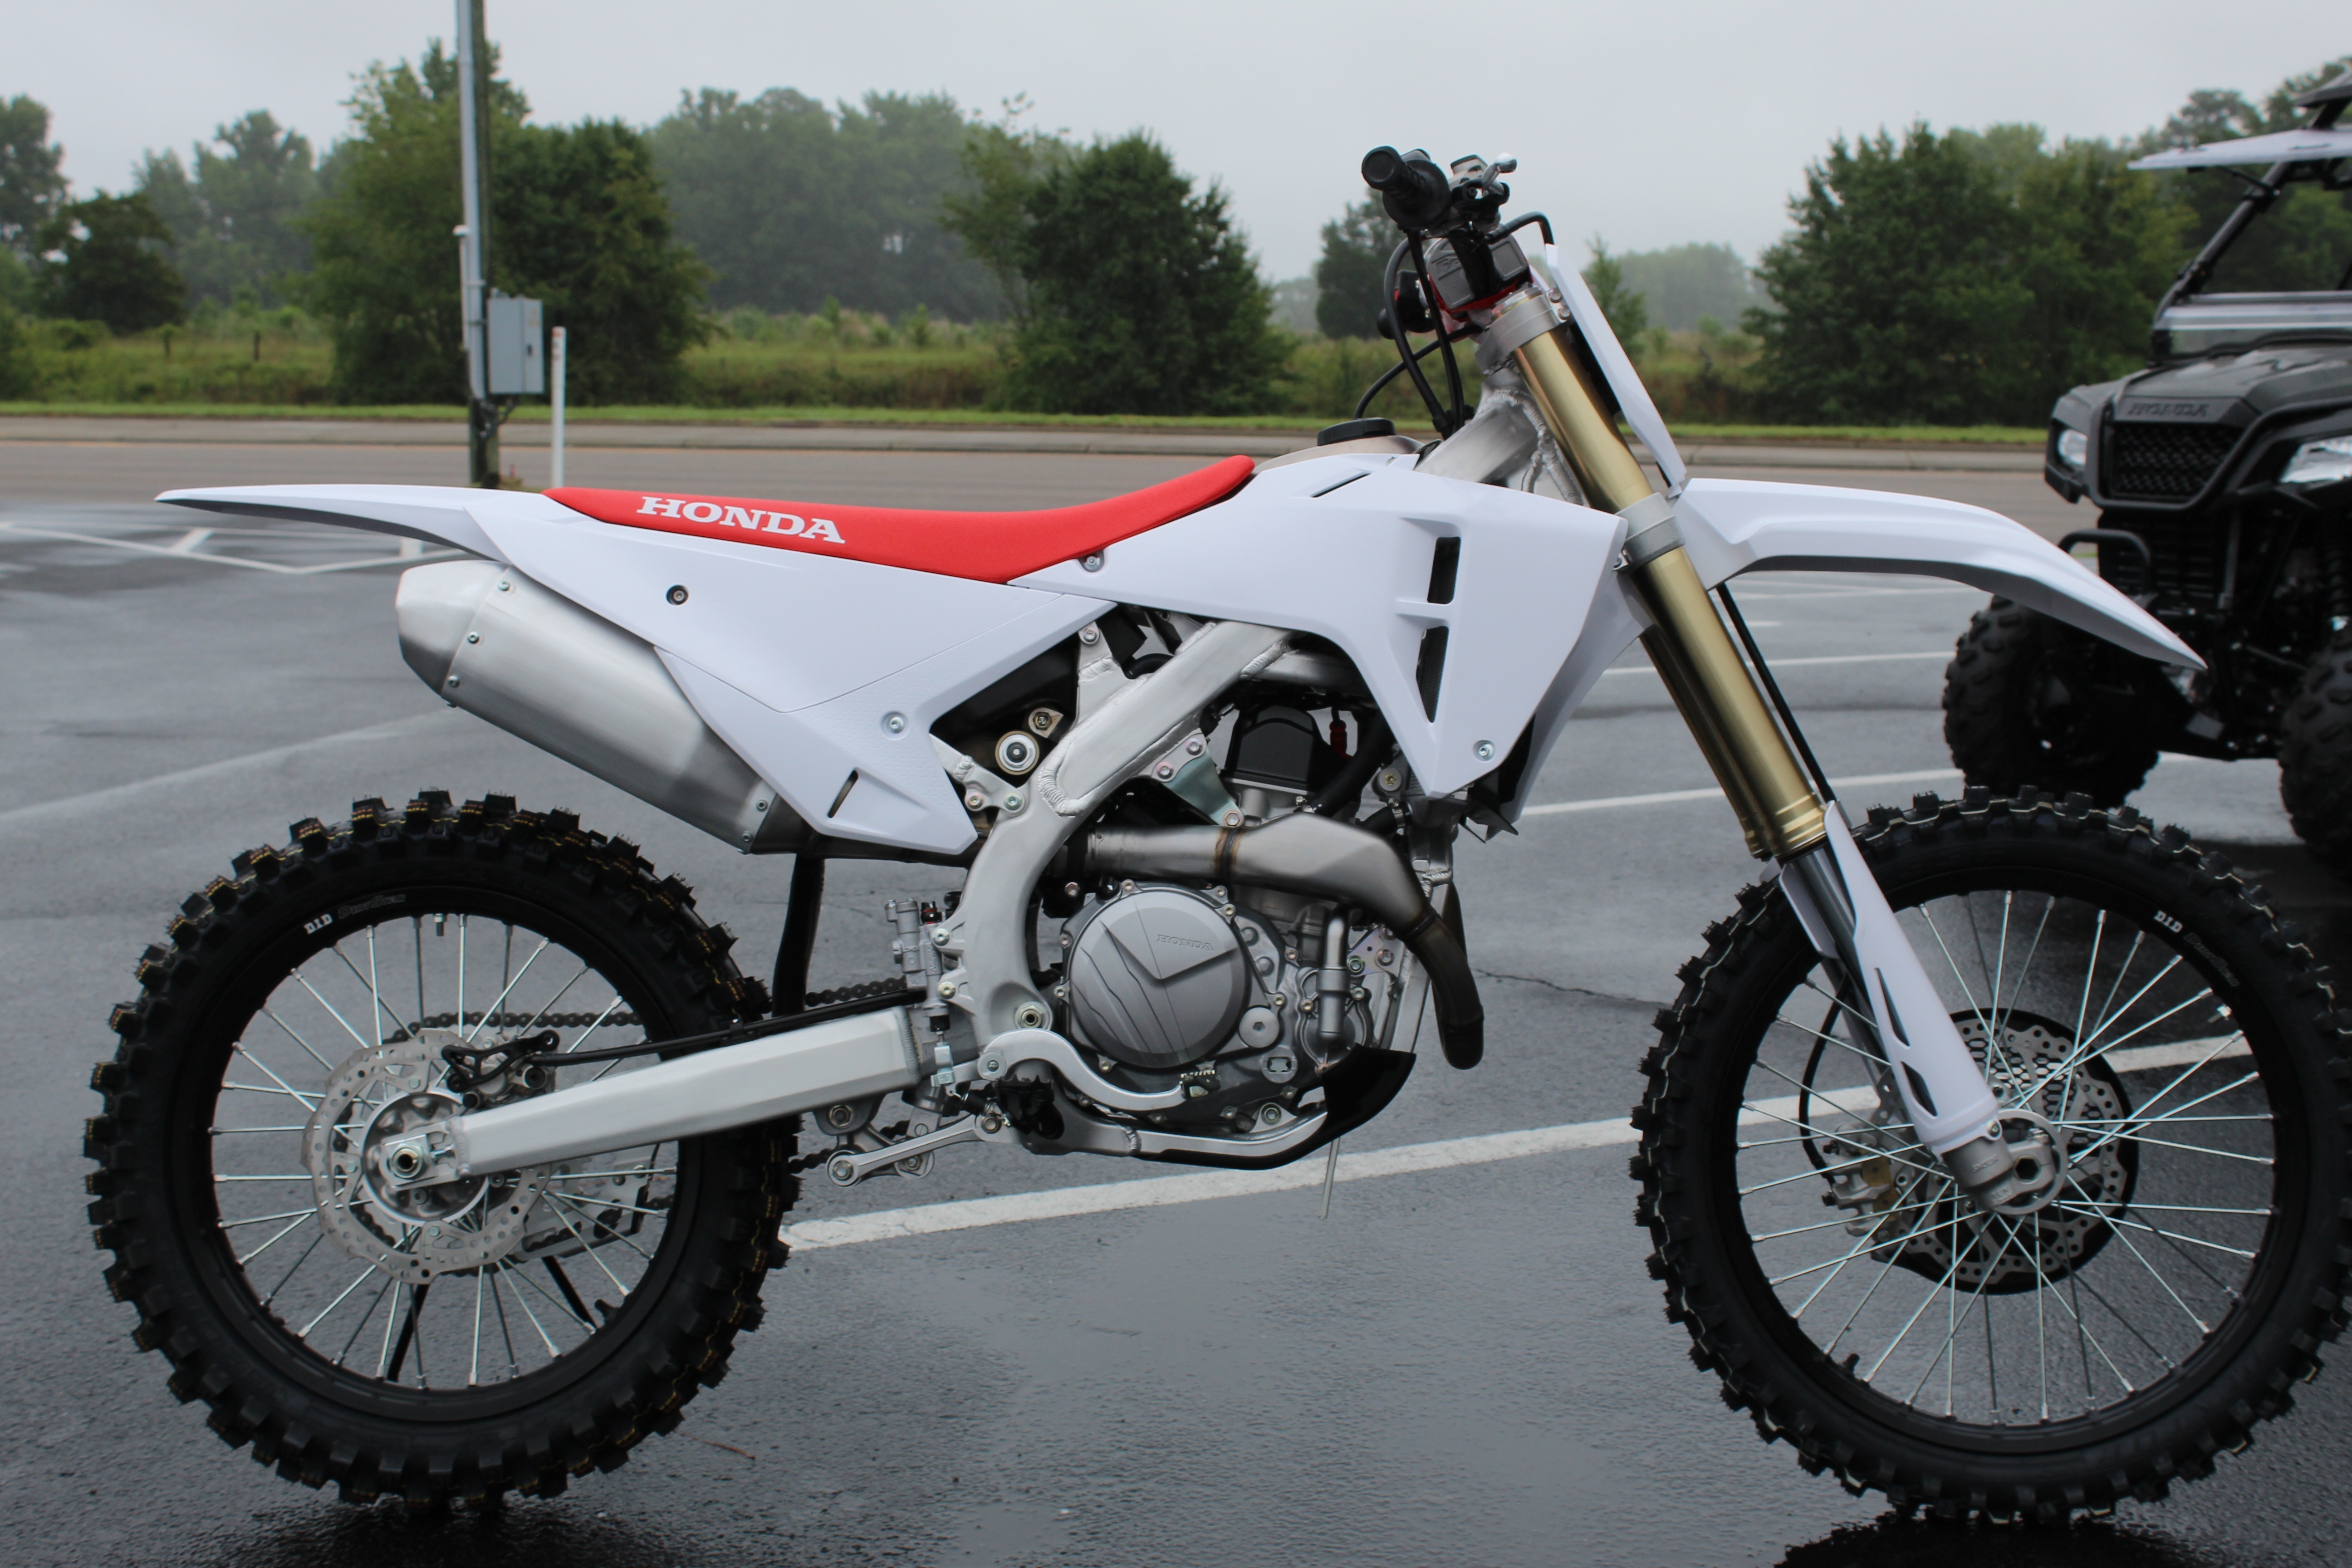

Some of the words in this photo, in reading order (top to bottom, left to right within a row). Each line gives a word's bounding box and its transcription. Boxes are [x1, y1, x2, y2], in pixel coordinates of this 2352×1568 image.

[2128, 402, 2210, 417] HONDA
[637, 496, 845, 544] HONDA
[1156, 934, 1214, 951] HONDA
